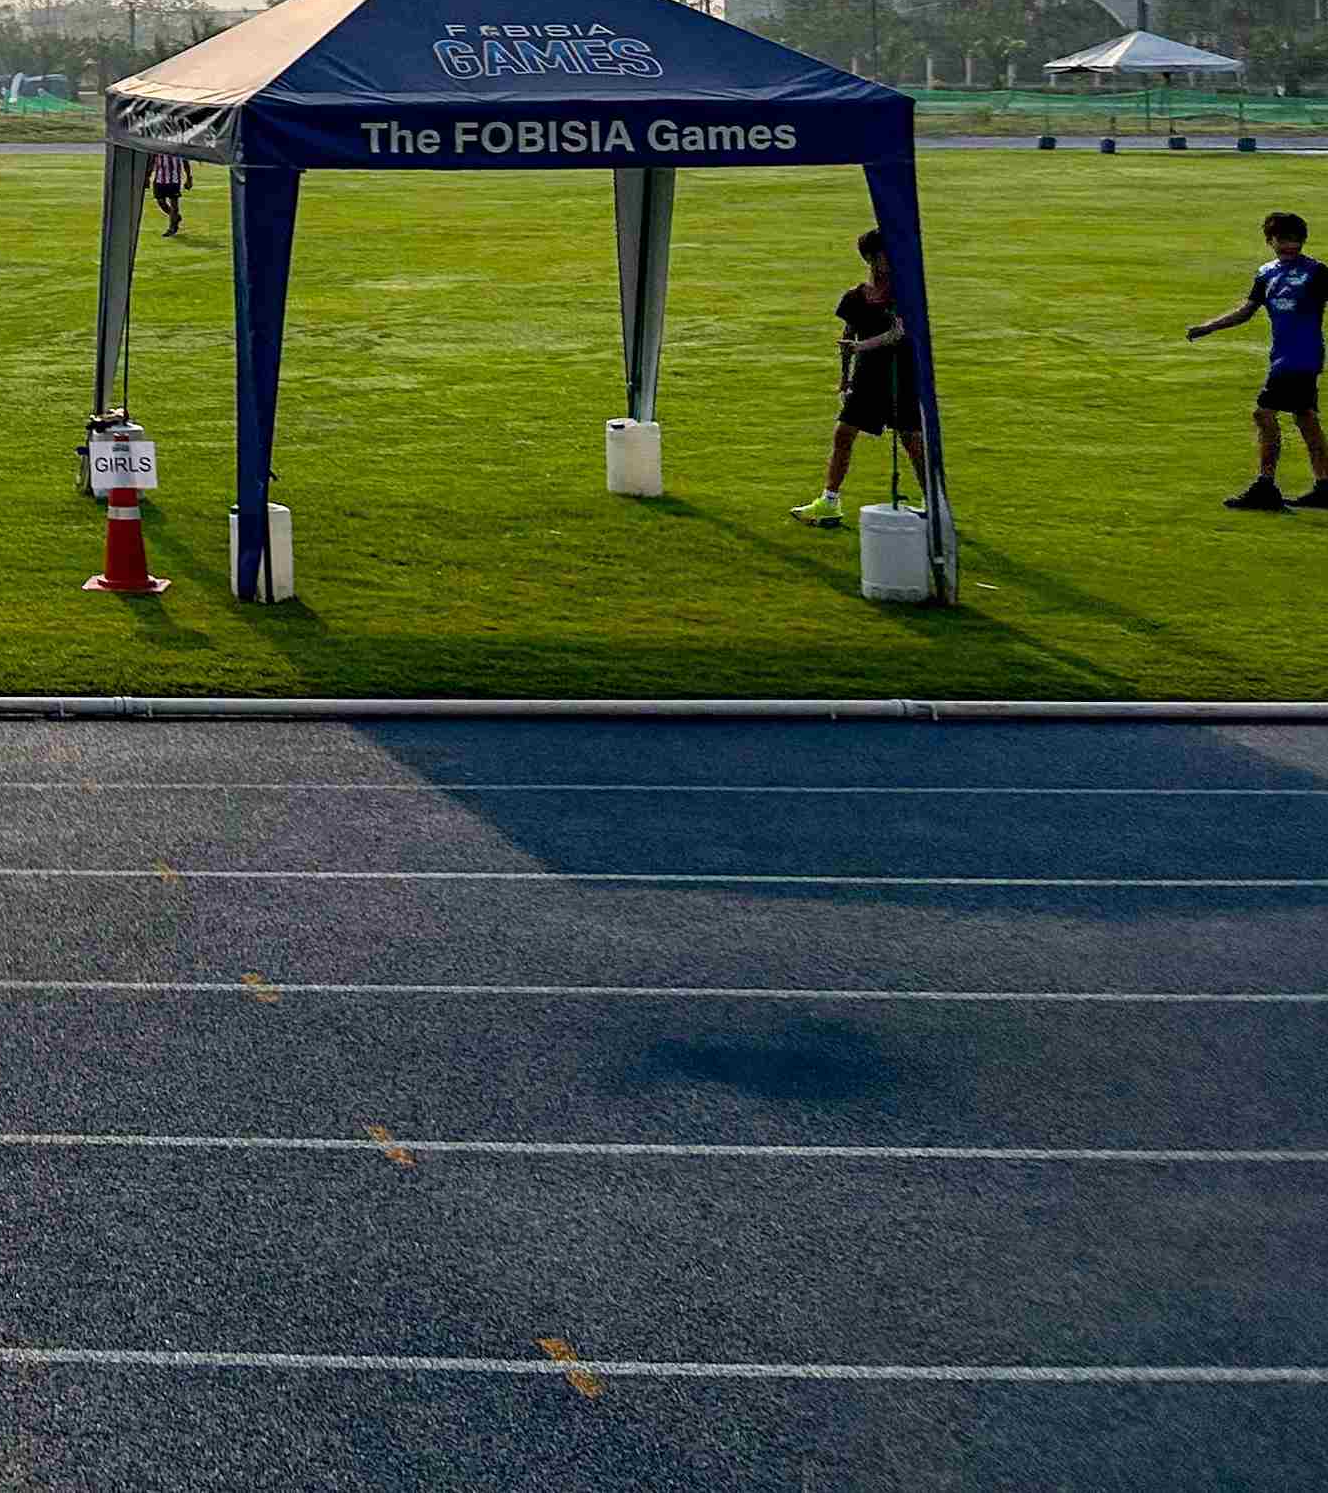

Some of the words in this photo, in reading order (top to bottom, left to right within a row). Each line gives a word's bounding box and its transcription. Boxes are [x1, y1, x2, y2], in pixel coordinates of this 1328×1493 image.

[432, 38, 664, 80] GAMES
[360, 120, 441, 154] The
[454, 120, 636, 153] FOBISIA
[647, 119, 797, 152] Games
[95, 456, 152, 473] GIRLS
